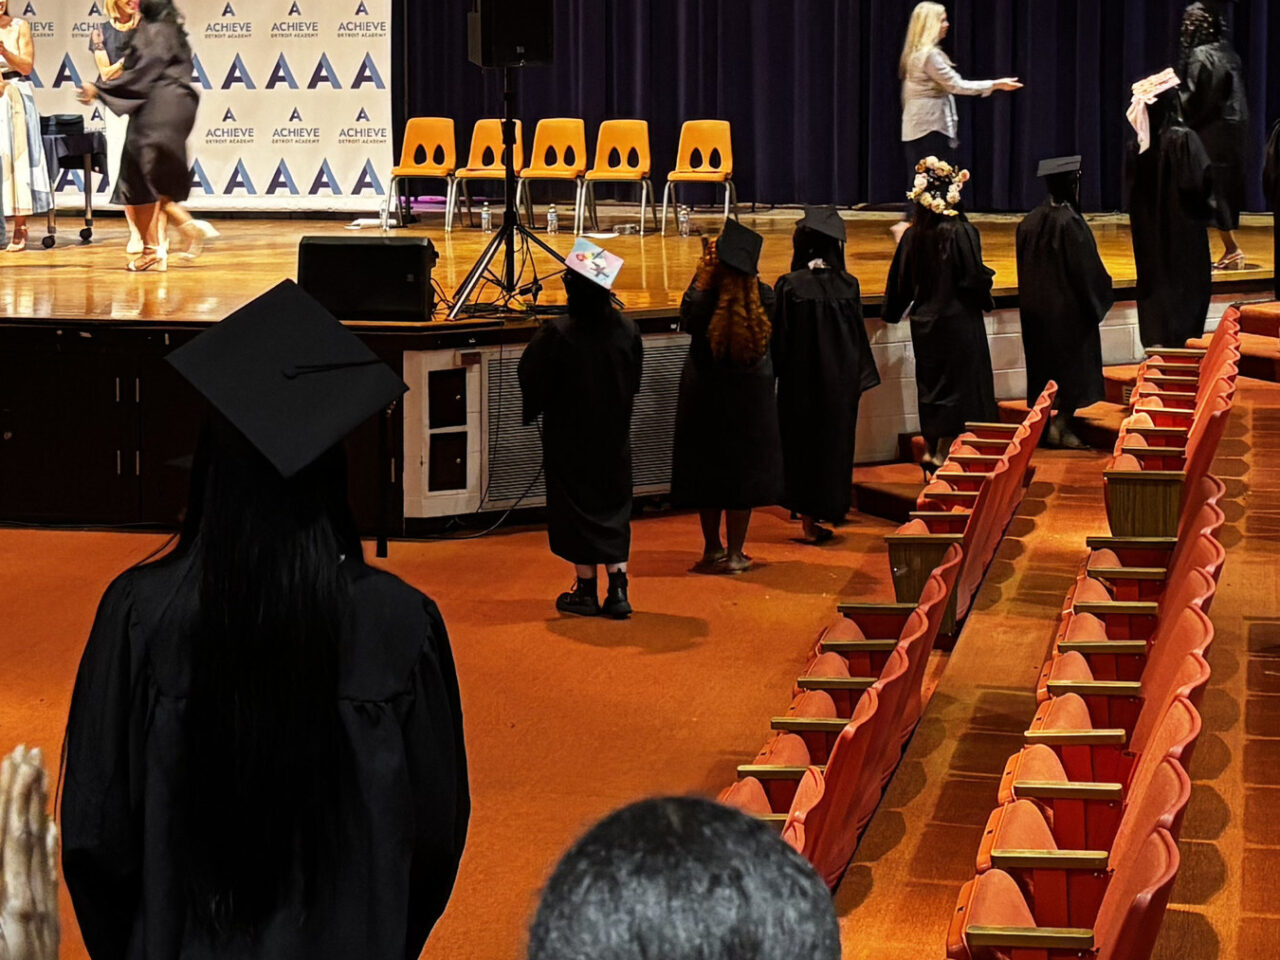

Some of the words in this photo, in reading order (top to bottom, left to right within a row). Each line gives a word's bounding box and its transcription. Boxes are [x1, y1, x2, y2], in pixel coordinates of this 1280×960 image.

[23, 1, 36, 16] A
[88, 1, 102, 16] A
[222, 2, 236, 17] A
[287, 1, 301, 16] A
[355, 0, 369, 15] A
[205, 22, 252, 32] ACHIEVE
[271, 22, 318, 32] ACHIEVE
[338, 21, 386, 32] ACHIEVE
[52, 52, 83, 88] A
[221, 52, 257, 90] A
[265, 52, 299, 90] A
[307, 52, 343, 90] A
[350, 52, 386, 90] A
[91, 106, 104, 121] A
[222, 107, 237, 122] A
[289, 107, 303, 122] A
[356, 107, 370, 122] A
[206, 128, 254, 138] ACHIEVE
[272, 128, 320, 138] ACHIEVE
[339, 128, 387, 138] ACHIEVE
[223, 158, 258, 195] A
[265, 158, 300, 195] A
[308, 158, 343, 195] A
[351, 158, 386, 195] A
